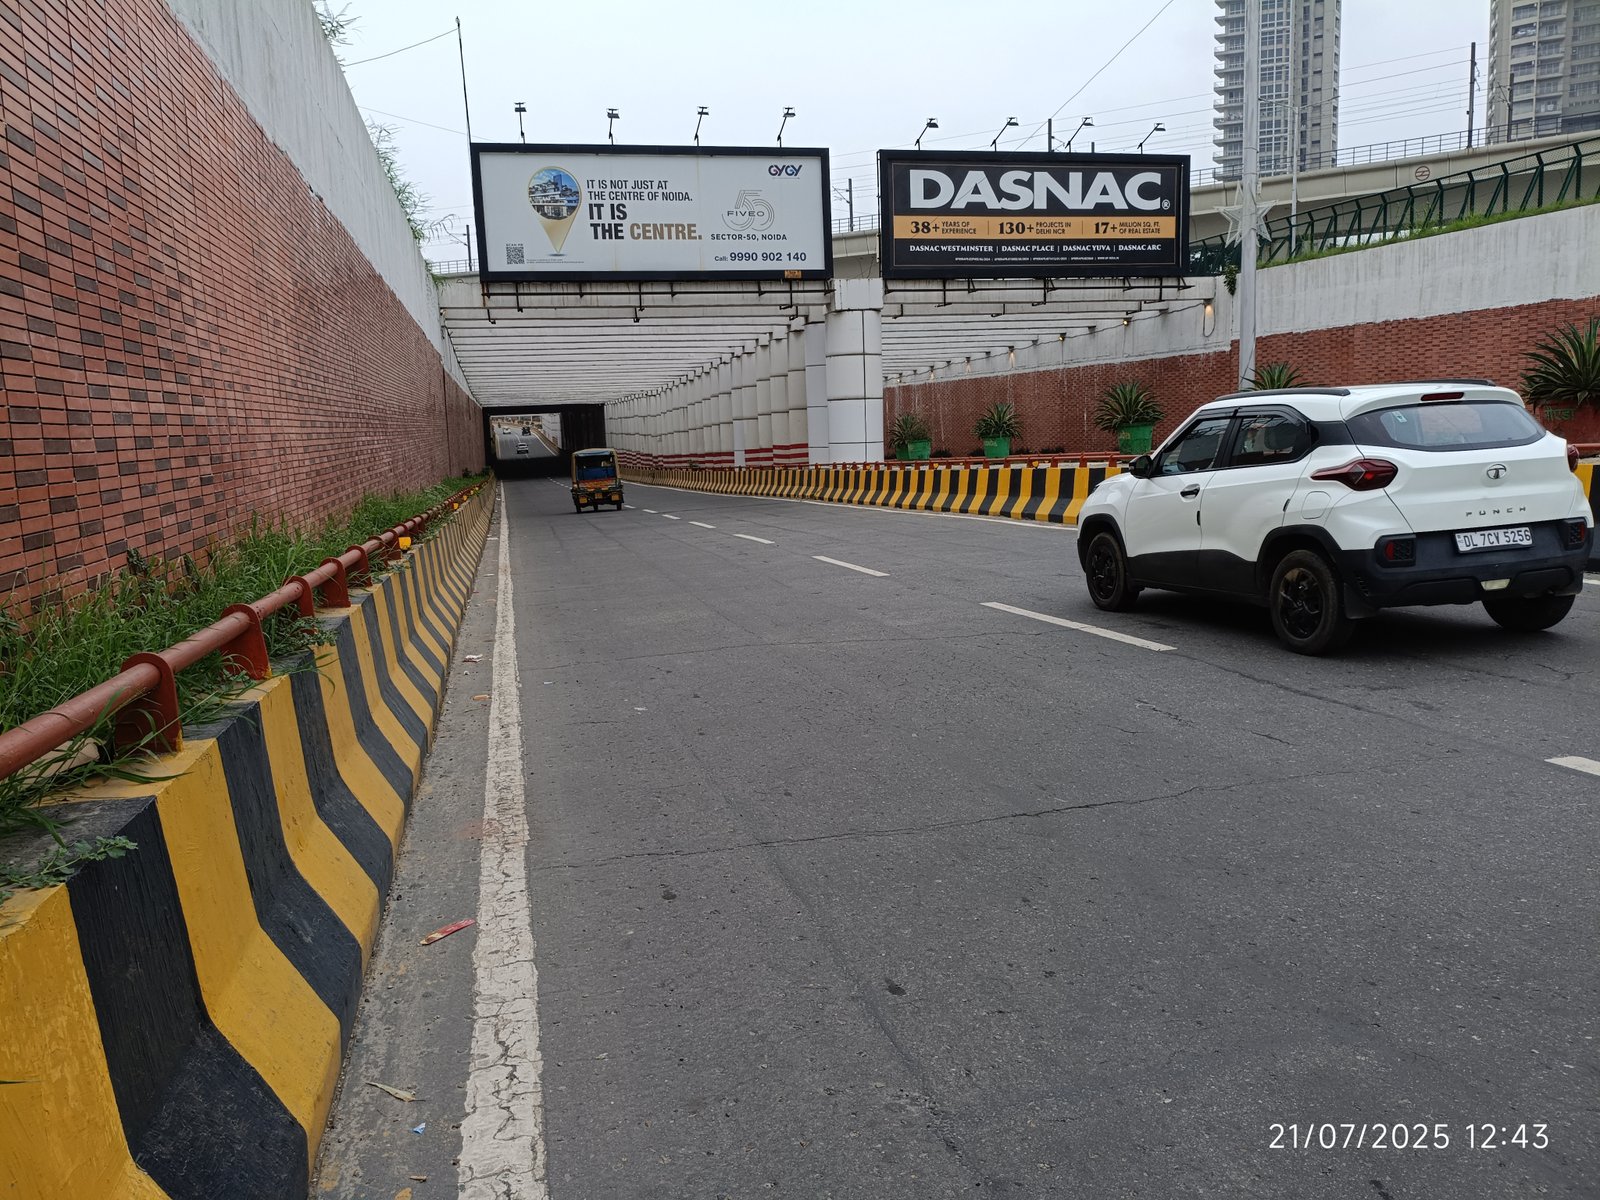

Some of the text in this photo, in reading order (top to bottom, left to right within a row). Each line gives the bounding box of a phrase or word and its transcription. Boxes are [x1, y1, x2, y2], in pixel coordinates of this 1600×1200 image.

[587, 179, 668, 190] IT IS NOT JUST AT
[588, 191, 693, 202] THE CENTRE OF NOIDA.
[588, 203, 628, 220] IT IS
[910, 221, 940, 234] 38+
[998, 221, 1035, 235] 130+
[1035, 221, 1064, 229] PROJECTS
[1094, 221, 1118, 235] 17+
[1142, 221, 1152, 229] SQ.
[590, 223, 702, 240] THE CENTRE.
[710, 234, 759, 242] SECTOR-50,
[1062, 244, 1091, 252] DASNAC
[729, 252, 758, 262] 9990
[761, 252, 782, 262] 902
[786, 252, 807, 262] 140
[1465, 506, 1527, 517] PUNCH
[1463, 534, 1478, 548] DL
[1480, 531, 1500, 546] 7CV
[1503, 529, 1531, 544] 5256
